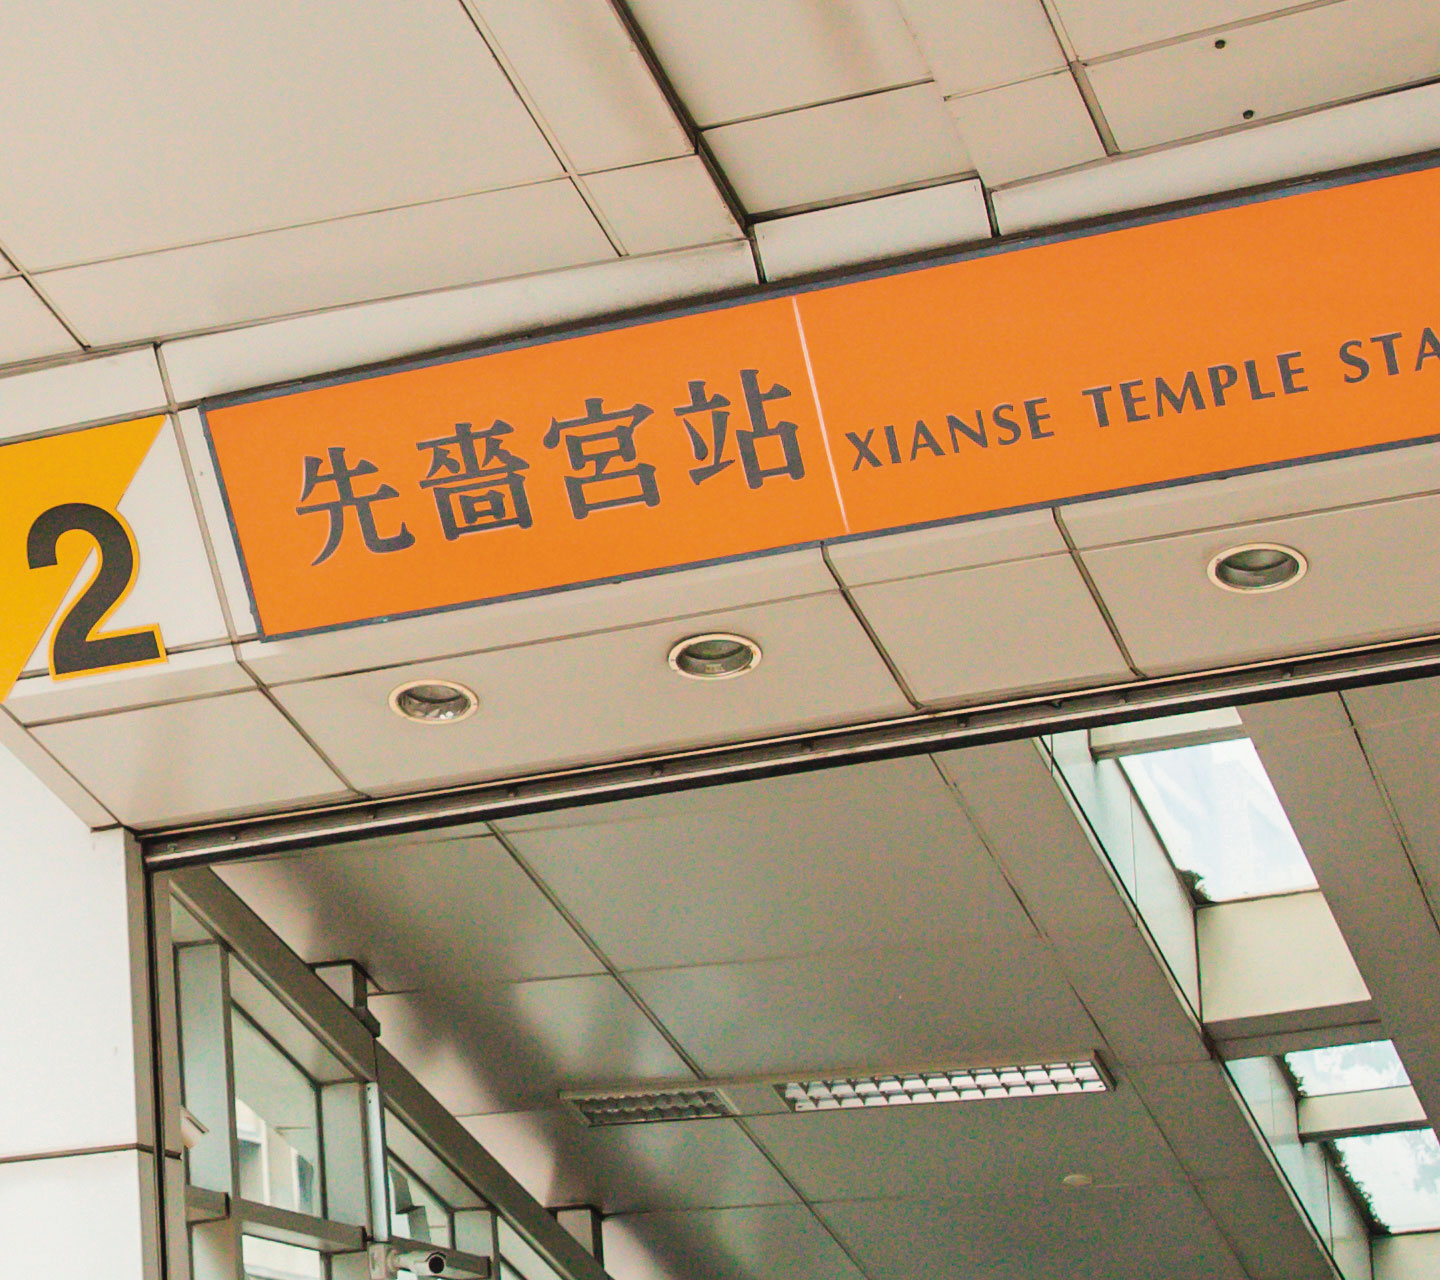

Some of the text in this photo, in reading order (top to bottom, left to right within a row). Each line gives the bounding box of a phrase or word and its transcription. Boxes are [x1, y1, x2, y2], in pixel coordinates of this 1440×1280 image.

[295, 369, 806, 566] 先嗇宮站
[843, 397, 1055, 472] XIANSE
[1081, 351, 1310, 429] TEMPLE
[27, 503, 161, 675] 2
